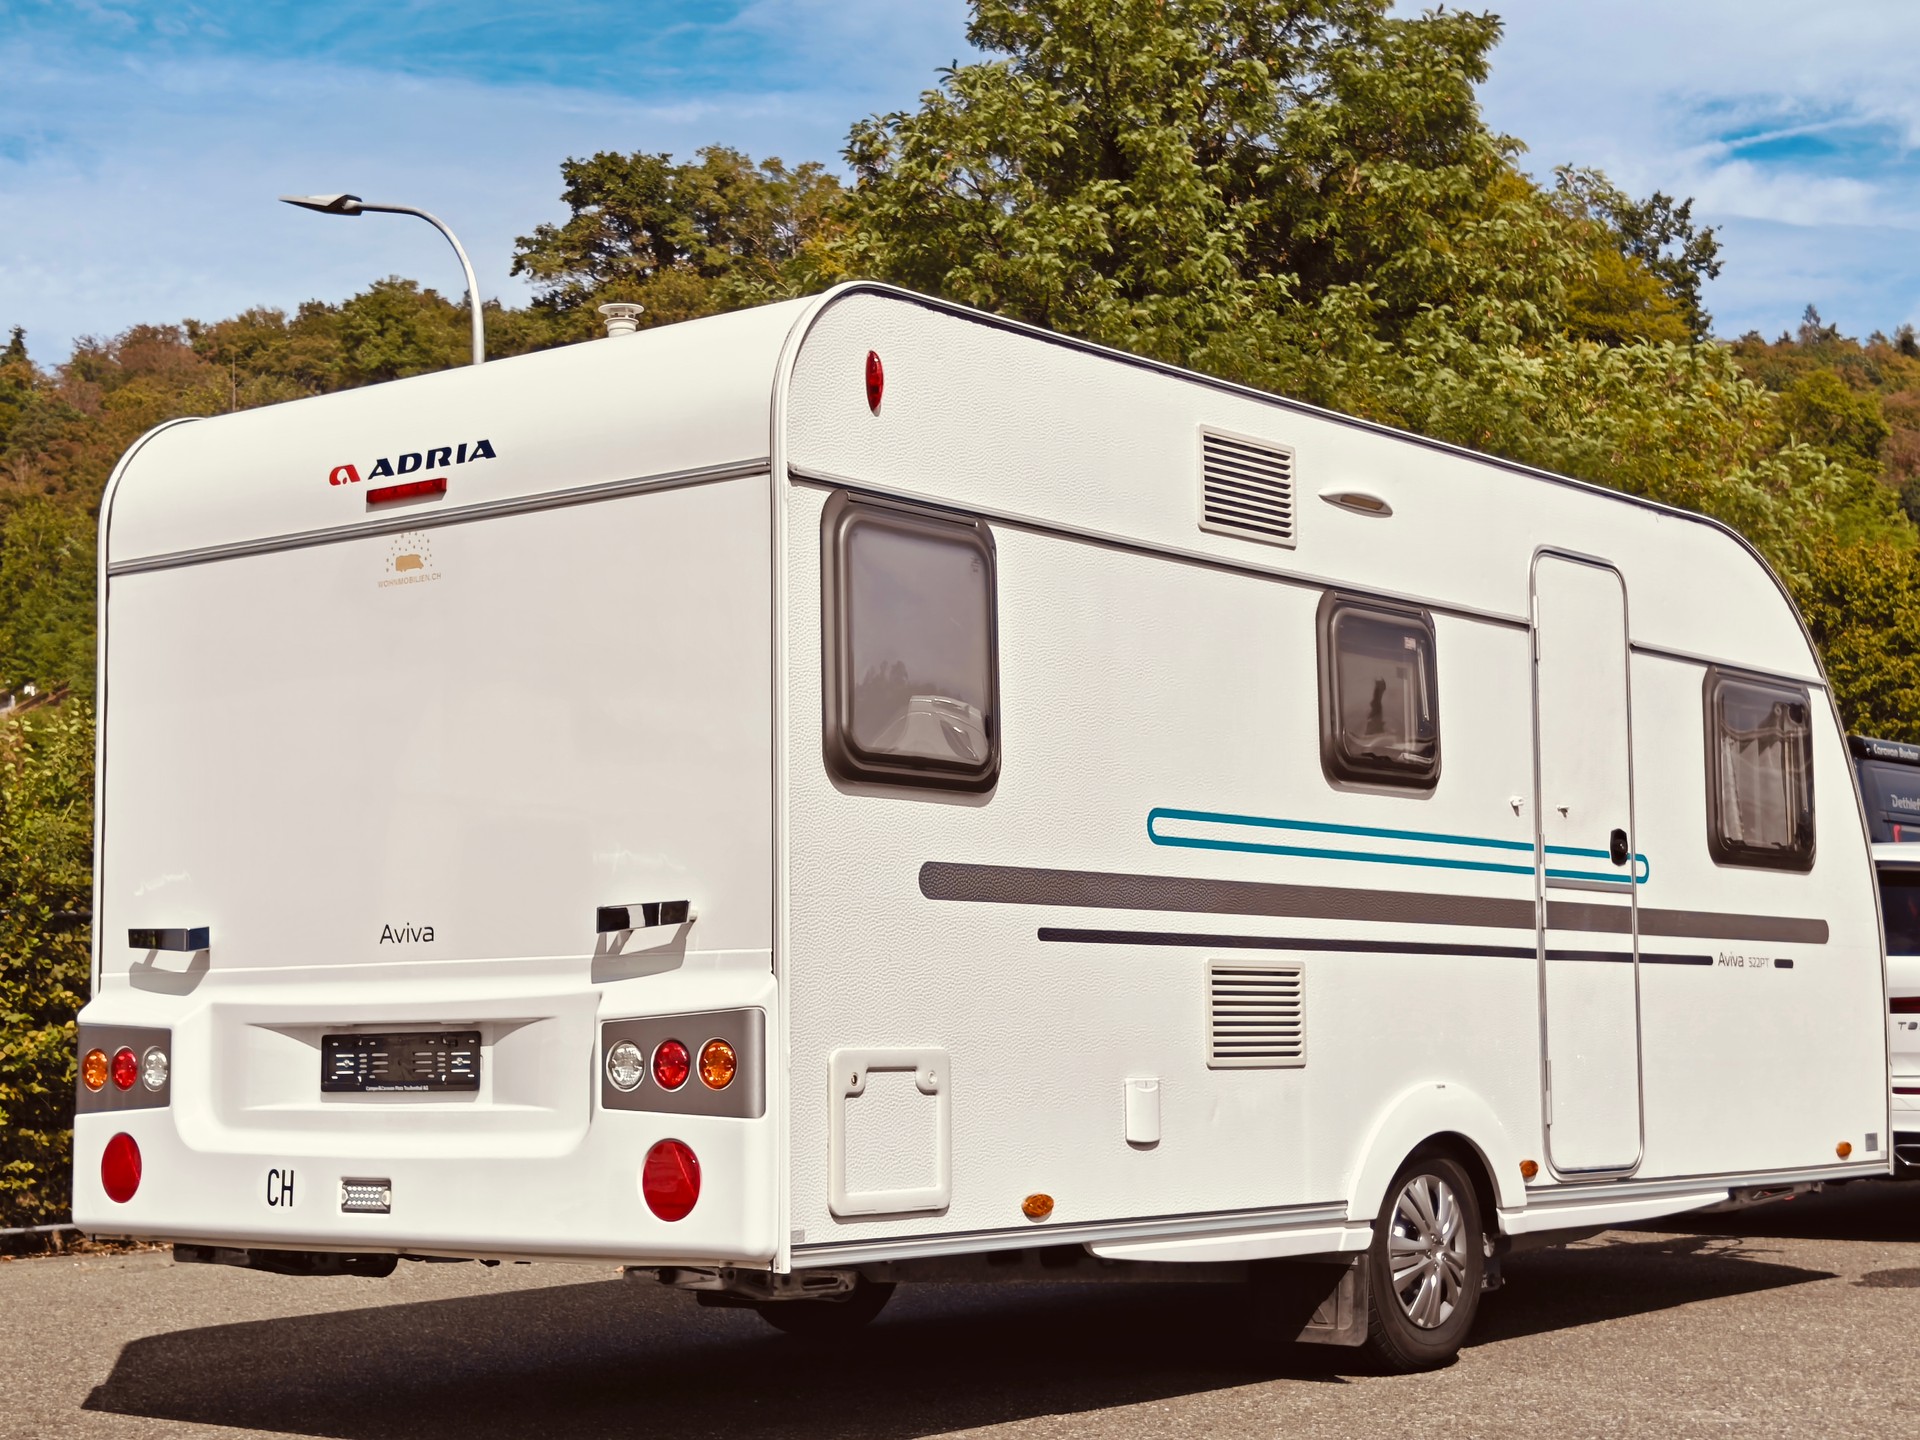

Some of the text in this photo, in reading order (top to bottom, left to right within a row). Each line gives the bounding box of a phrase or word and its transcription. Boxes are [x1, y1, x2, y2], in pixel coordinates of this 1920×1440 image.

[367, 439, 497, 481] ADRIA
[379, 922, 436, 944] Aviva
[1717, 951, 1744, 967] Aviva
[267, 1168, 295, 1208] CH
